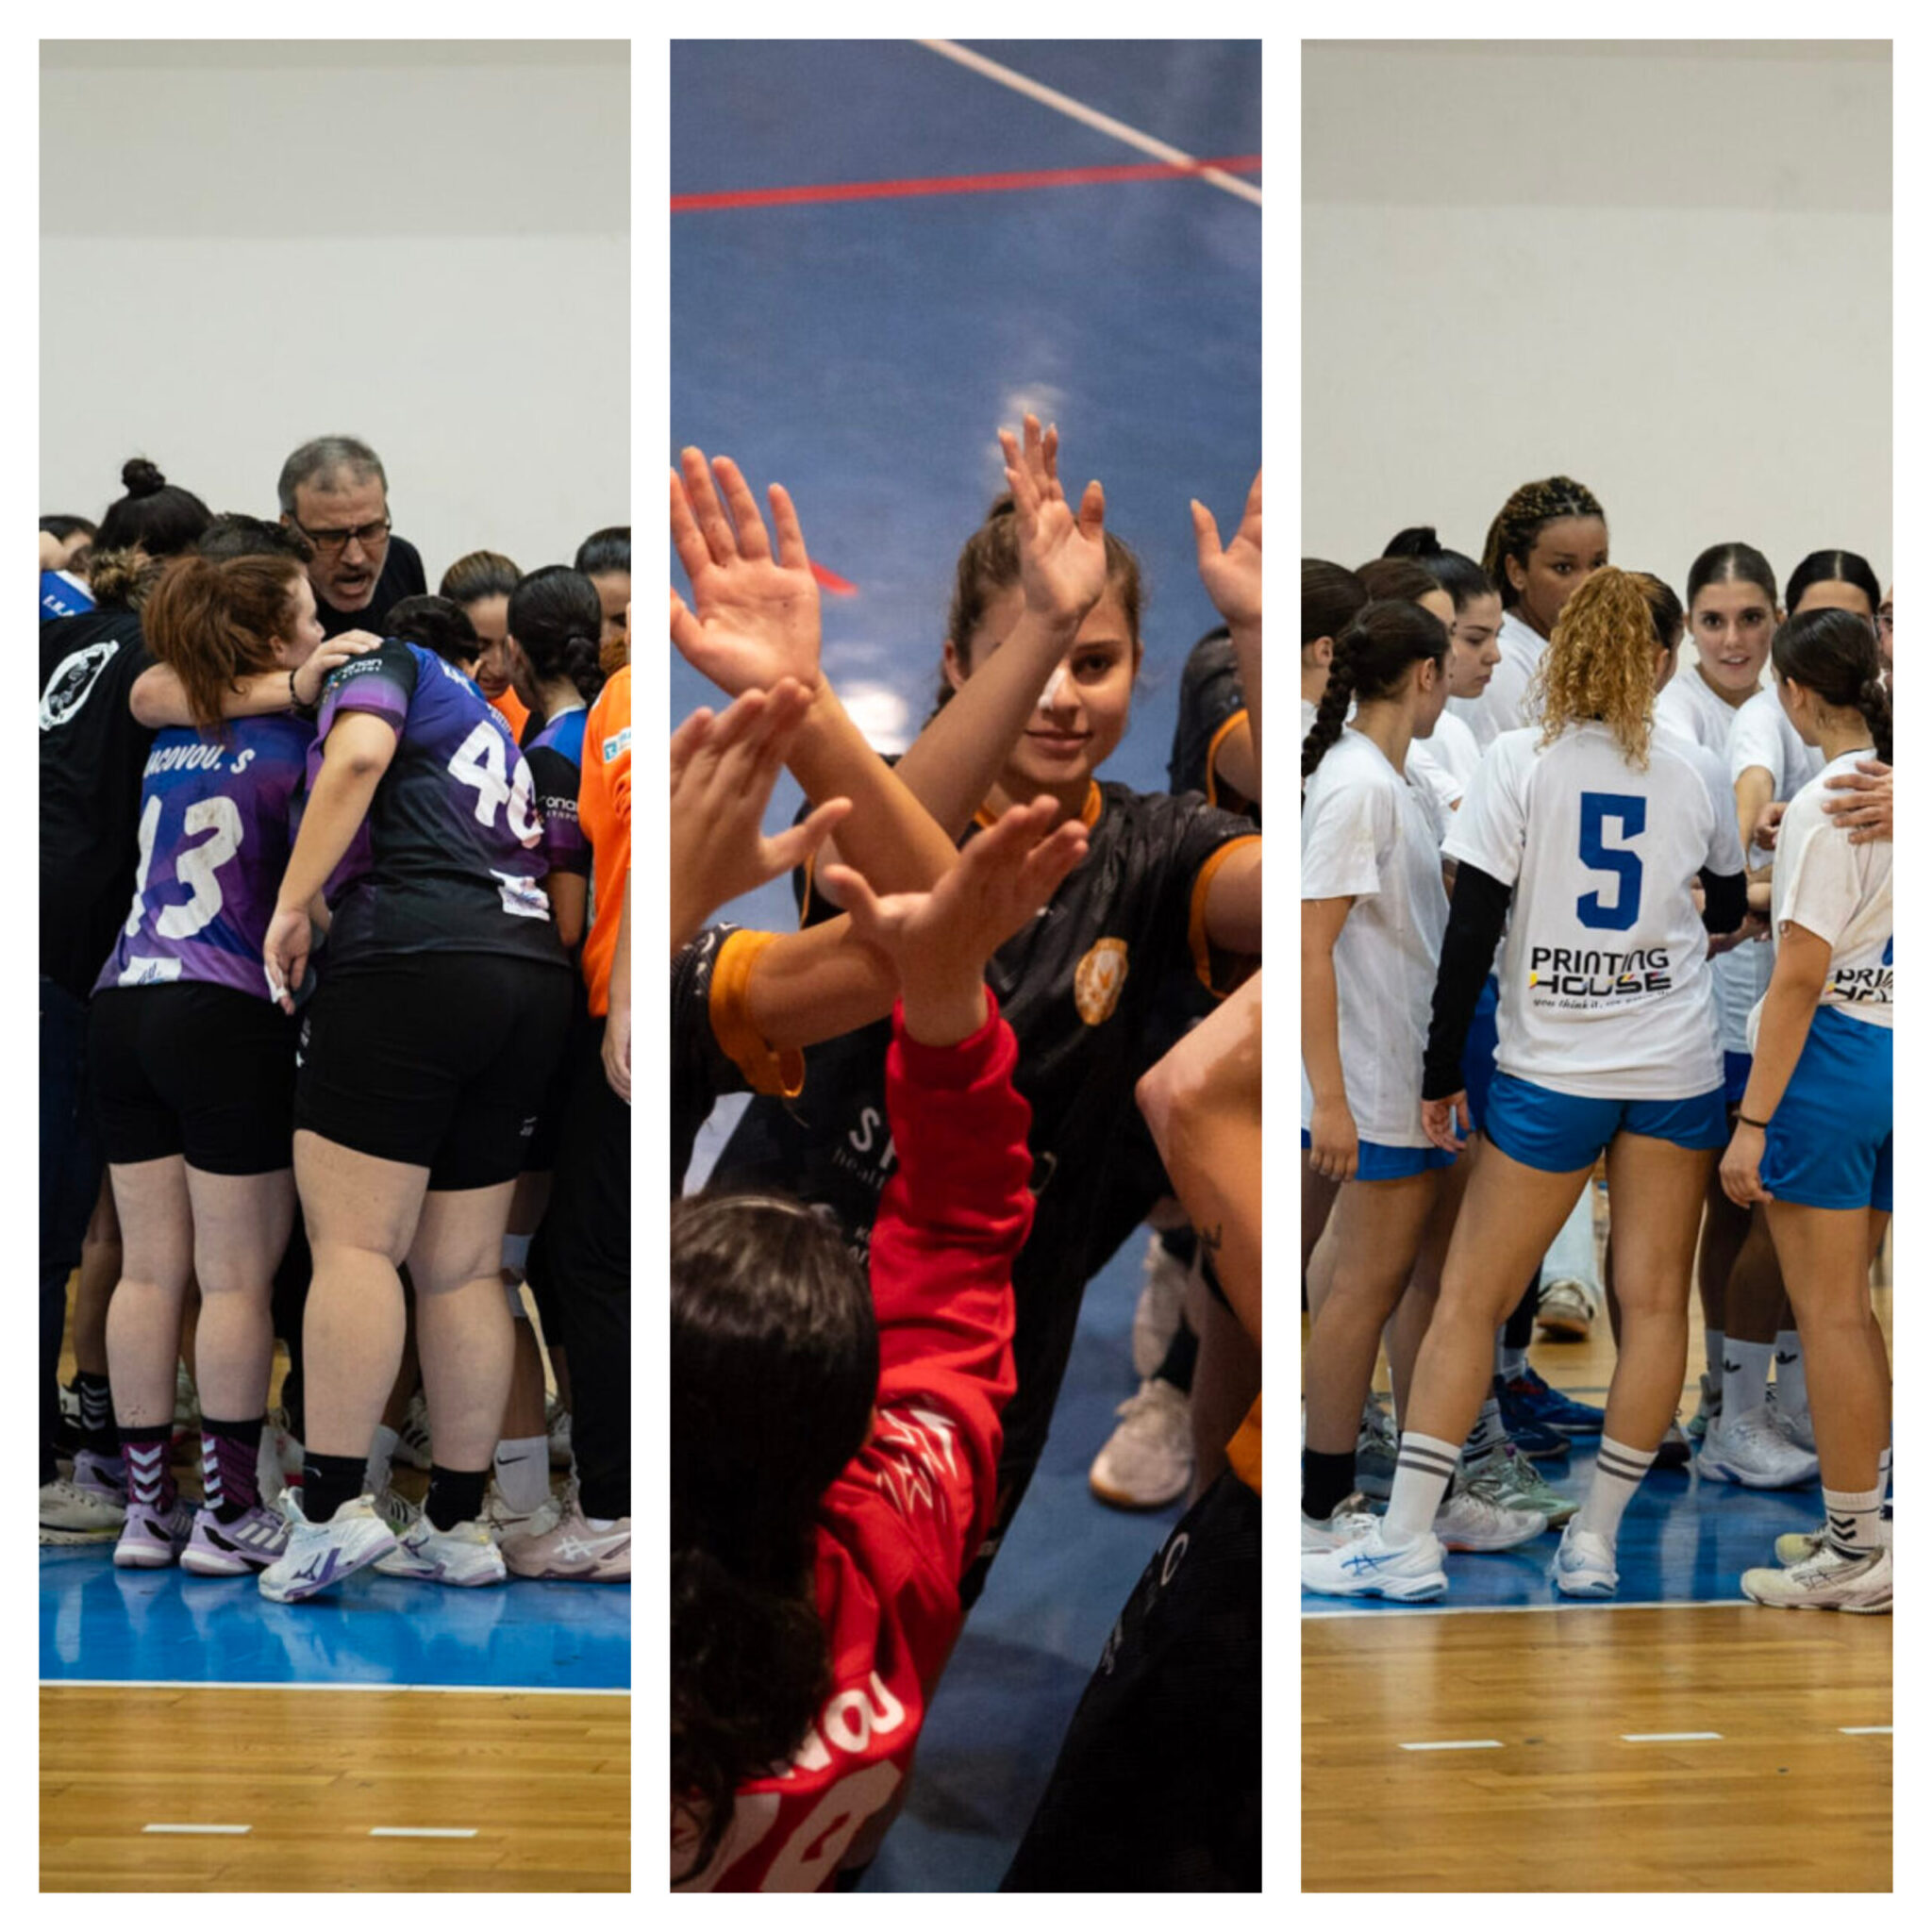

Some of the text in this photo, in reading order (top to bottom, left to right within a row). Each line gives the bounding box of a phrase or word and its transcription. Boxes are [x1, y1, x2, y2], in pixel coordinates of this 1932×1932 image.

[230, 748, 256, 774] S
[125, 794, 243, 940] 13
[1576, 791, 1647, 931] 5
[1531, 946, 1670, 975] PRINTING
[1529, 971, 1672, 996] HOUSE
